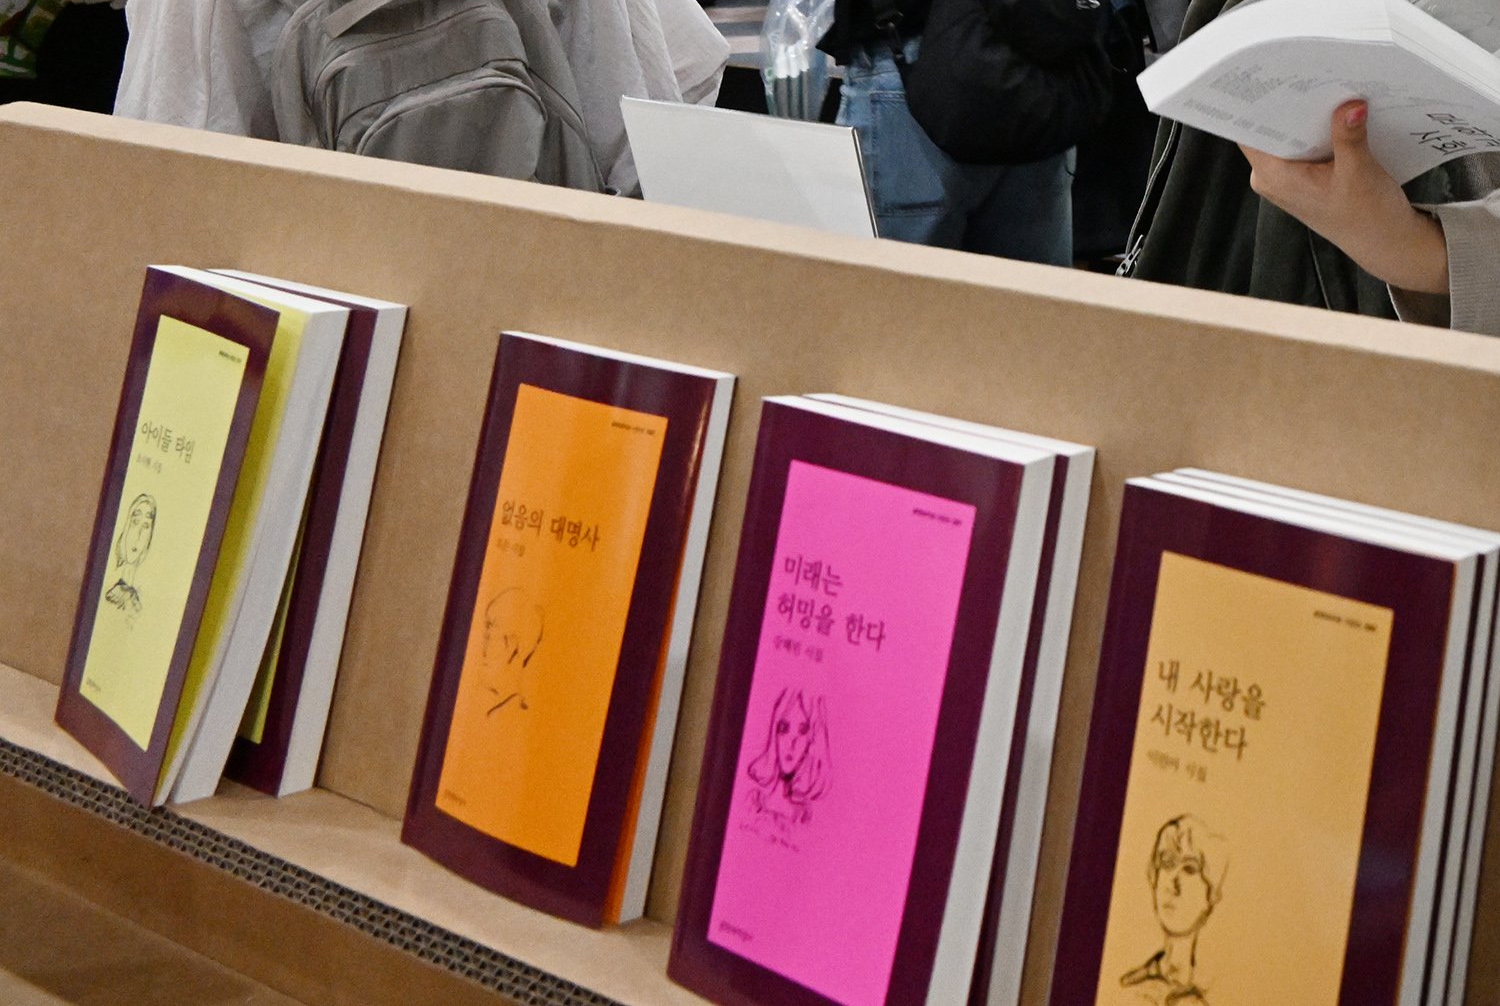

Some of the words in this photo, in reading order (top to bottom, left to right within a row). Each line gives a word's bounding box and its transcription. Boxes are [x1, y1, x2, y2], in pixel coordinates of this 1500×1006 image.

[141, 420, 173, 453] 아이들
[502, 500, 545, 536] 없음의
[550, 516, 600, 552] 대명사
[785, 555, 843, 596] 미래는
[777, 593, 836, 636] 허밍을
[846, 613, 886, 650] 한다
[1158, 660, 1180, 693] 내
[1190, 669, 1266, 721] 사랑을
[1151, 703, 1248, 761] 시작한다
